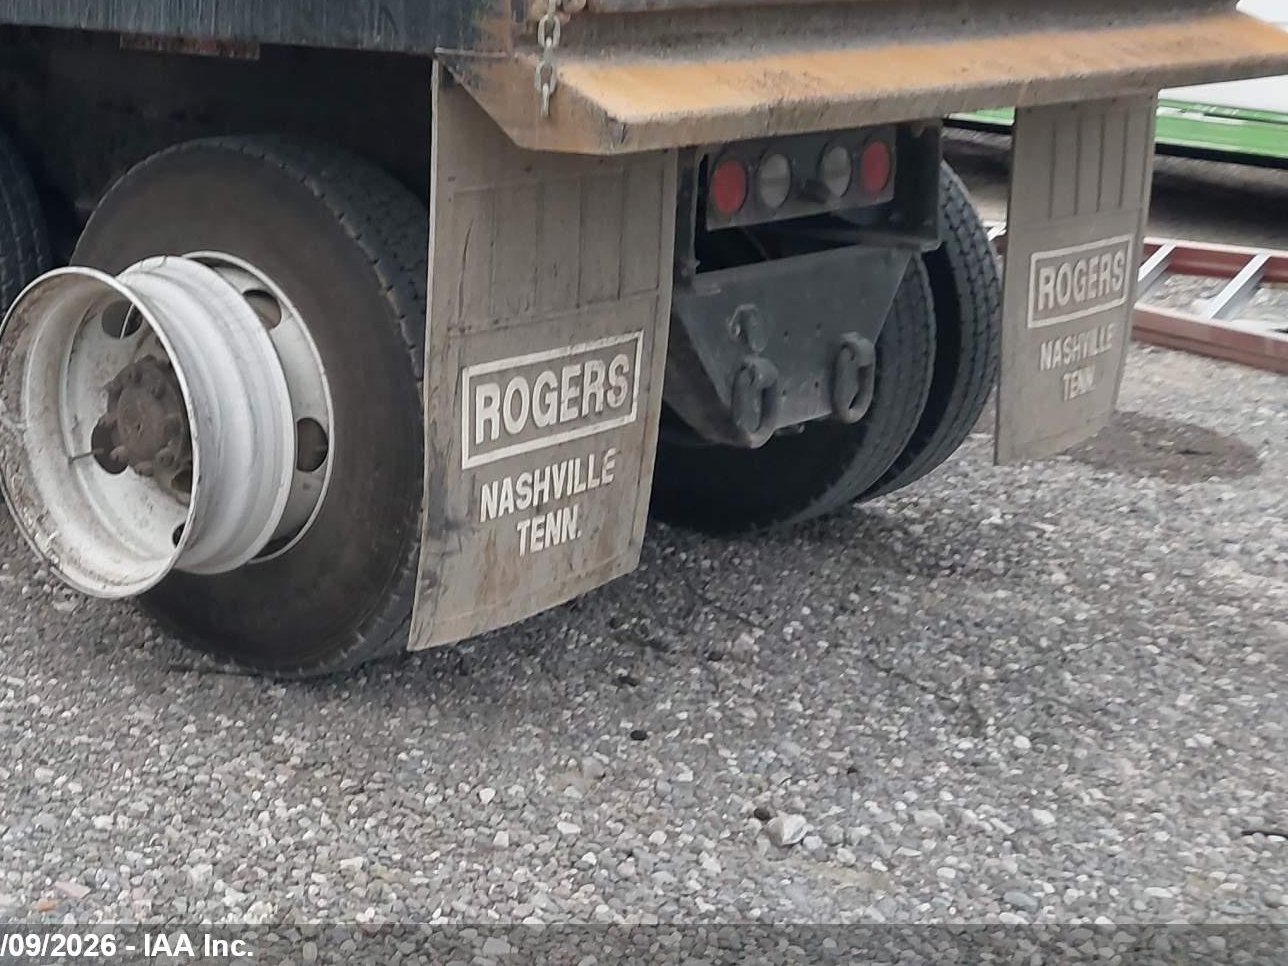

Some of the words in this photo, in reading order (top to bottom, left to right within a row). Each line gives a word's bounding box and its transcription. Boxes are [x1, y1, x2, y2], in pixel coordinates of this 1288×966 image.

[1038, 249, 1125, 311] ROGERS
[1040, 322, 1117, 371] NASHVILLE
[475, 353, 630, 445] ROGERS
[480, 448, 617, 522] NASHVILLE
[517, 504, 582, 556] TENN.
